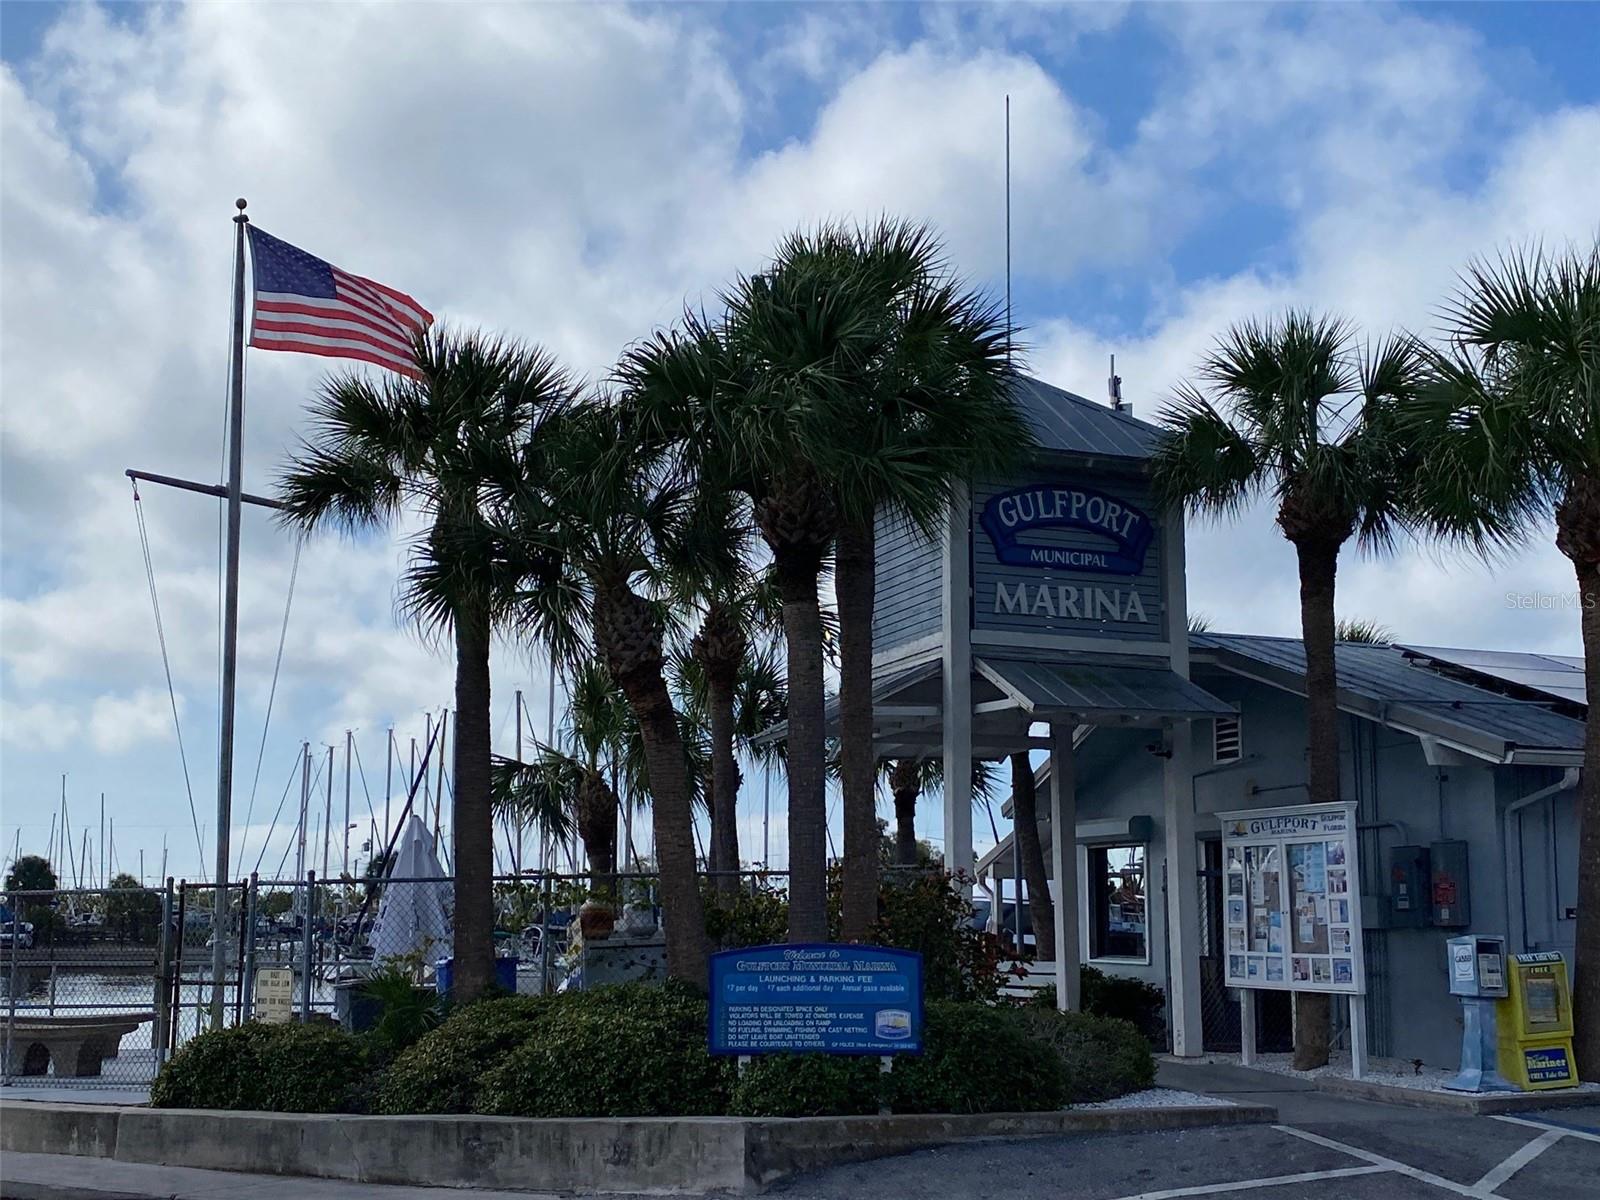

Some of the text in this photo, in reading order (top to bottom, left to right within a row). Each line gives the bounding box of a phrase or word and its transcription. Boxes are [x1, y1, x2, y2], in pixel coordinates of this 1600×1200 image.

[998, 489, 1140, 539] GULFPORT
[1030, 548, 1109, 568] MUNICIPAL
[994, 581, 1148, 623] MARINA
[1250, 816, 1318, 834] GULFPORT
[748, 984, 758, 992] day
[823, 984, 834, 992] day
